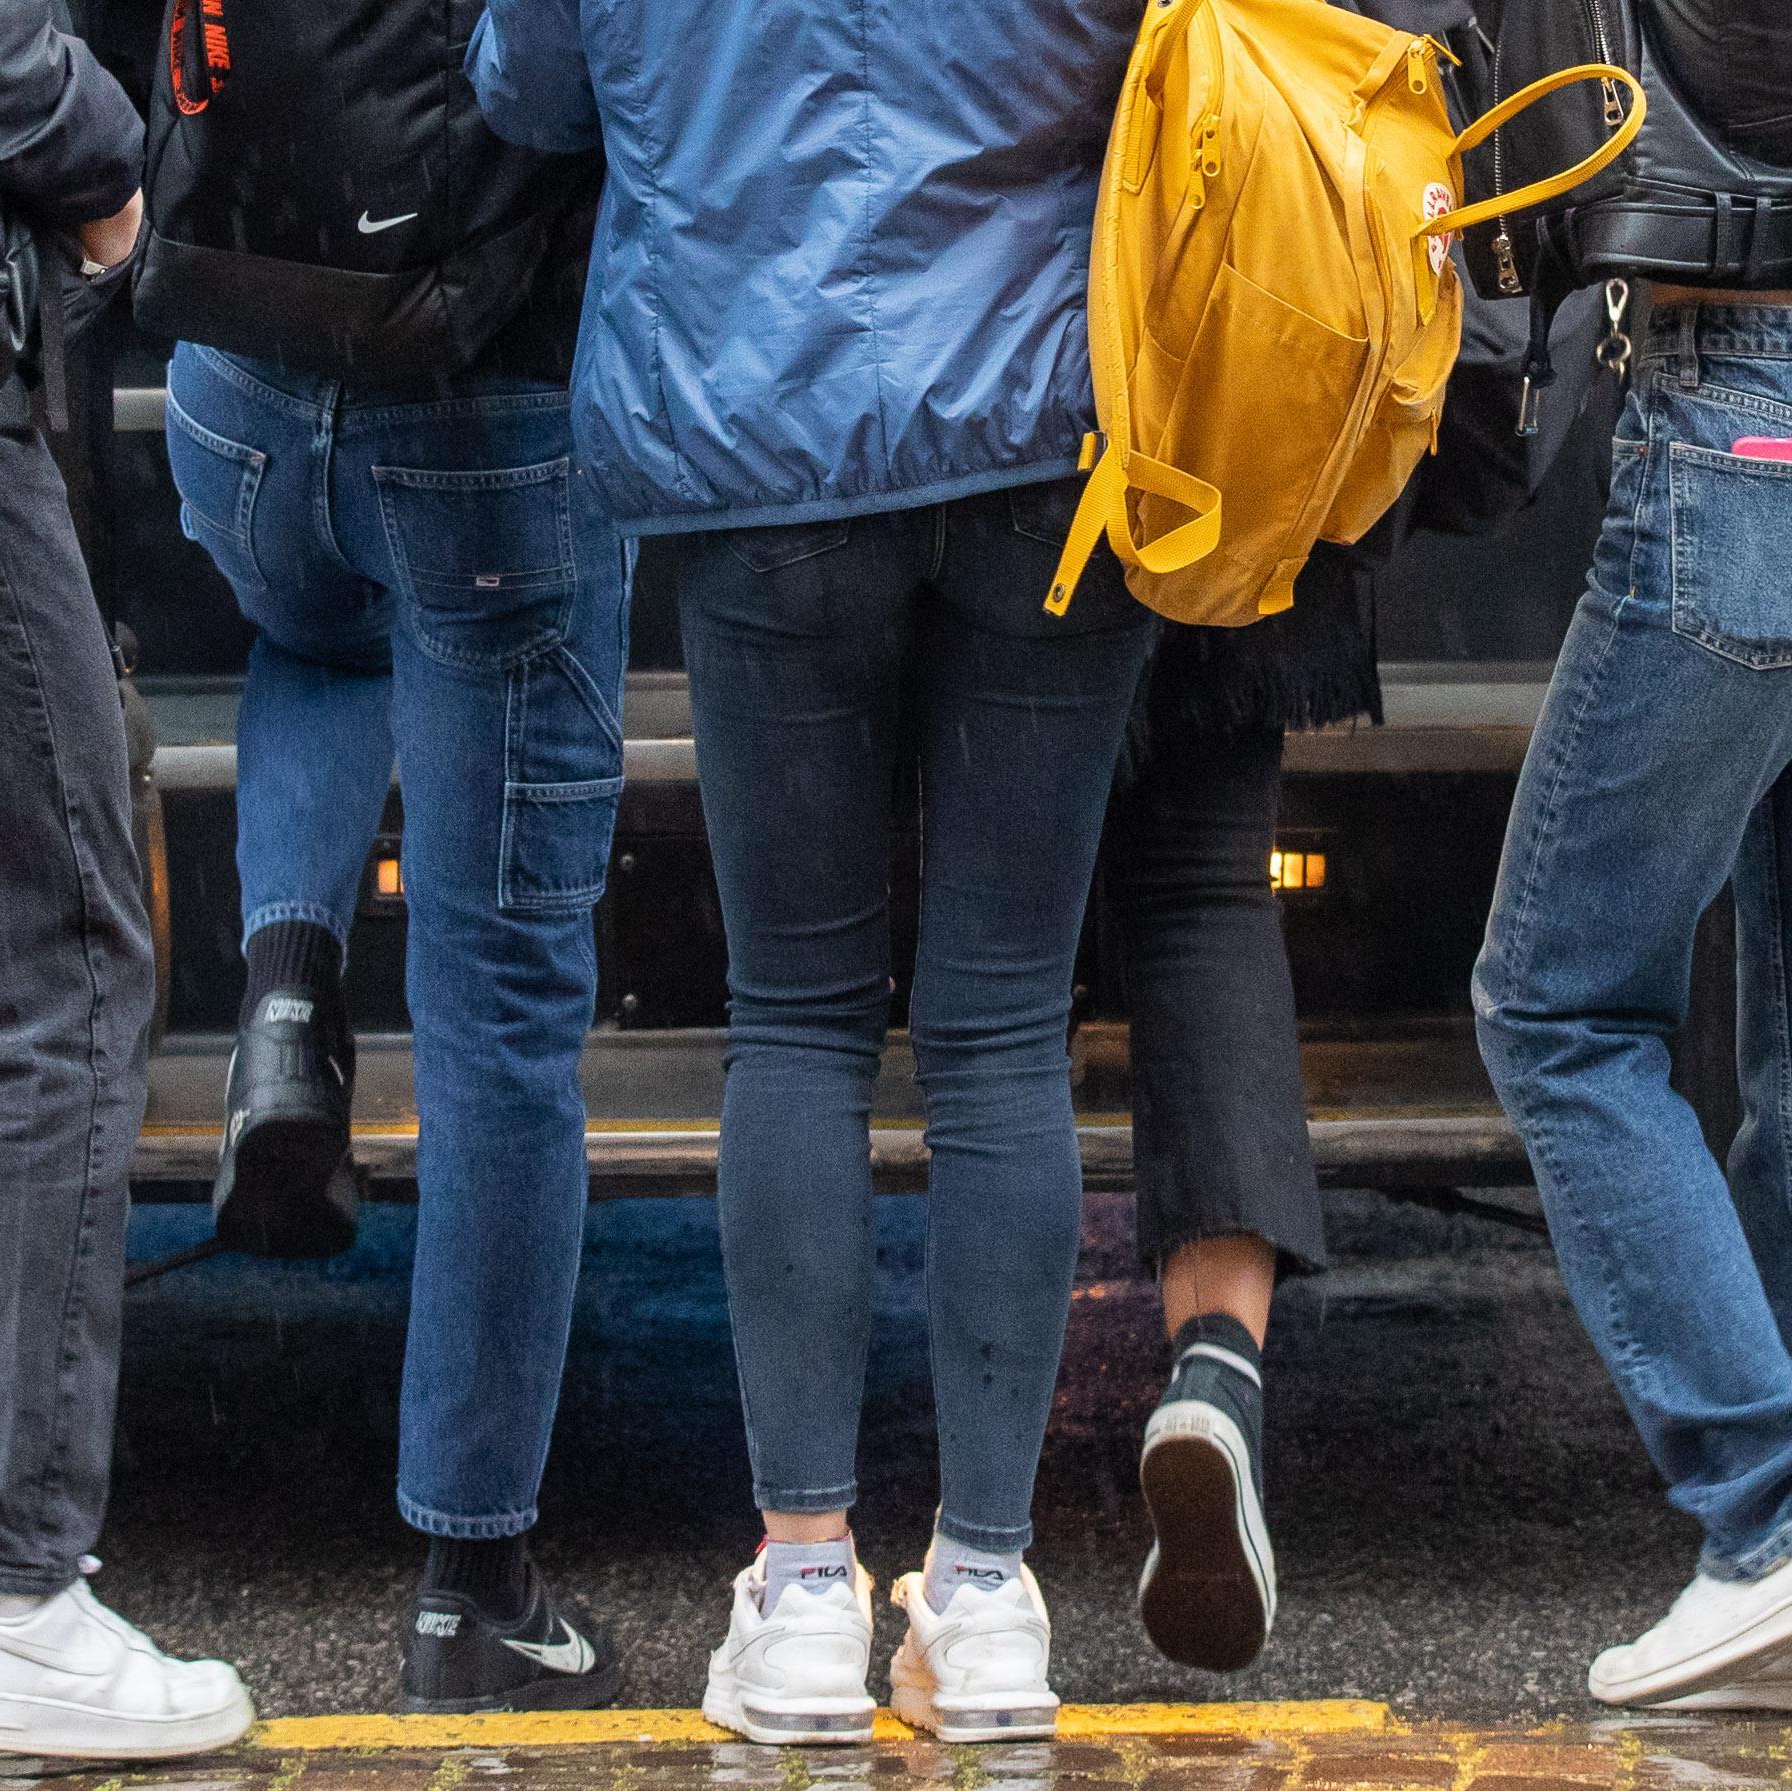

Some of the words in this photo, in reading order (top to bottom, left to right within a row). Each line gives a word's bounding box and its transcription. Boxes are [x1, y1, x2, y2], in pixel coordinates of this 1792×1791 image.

[204, 24, 231, 70] NIKE
[800, 1564, 848, 1579] FILA
[954, 1564, 1005, 1580] FILA
[415, 1611, 462, 1638] NIKE
